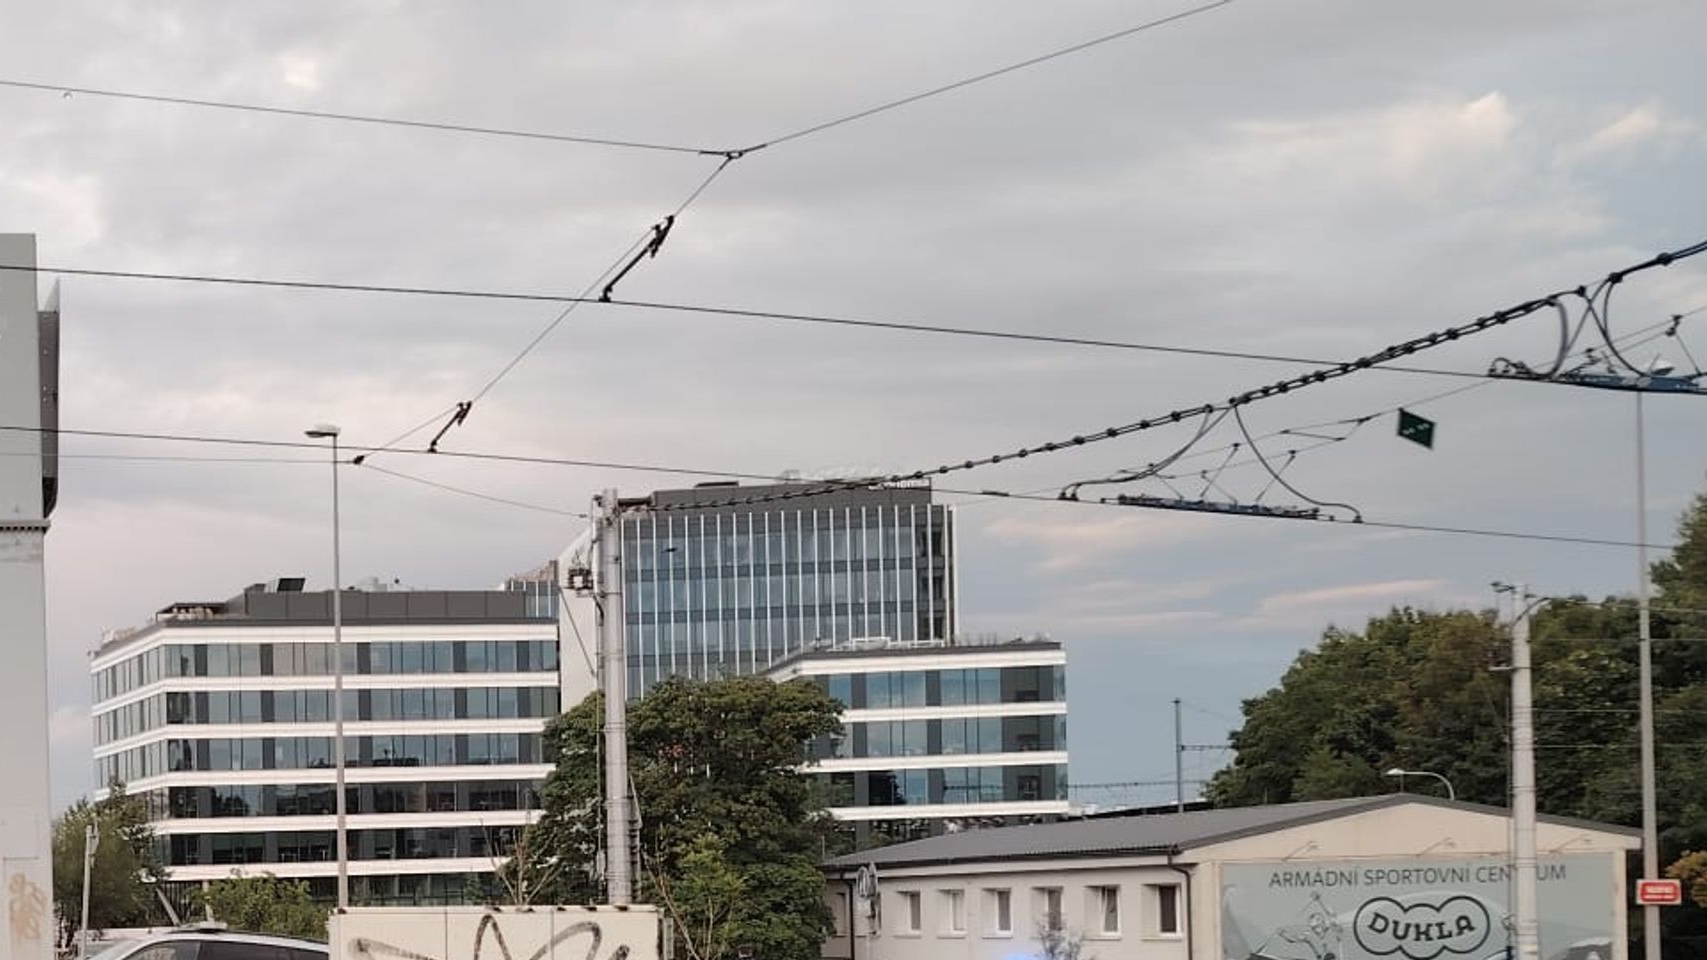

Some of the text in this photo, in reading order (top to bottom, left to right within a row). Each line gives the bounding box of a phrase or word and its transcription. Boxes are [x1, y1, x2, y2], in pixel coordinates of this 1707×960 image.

[1269, 864, 1567, 888] ARMÁDNÍ SPORTOVNÍ CENUM
[1368, 912, 1476, 942] DUKLA
